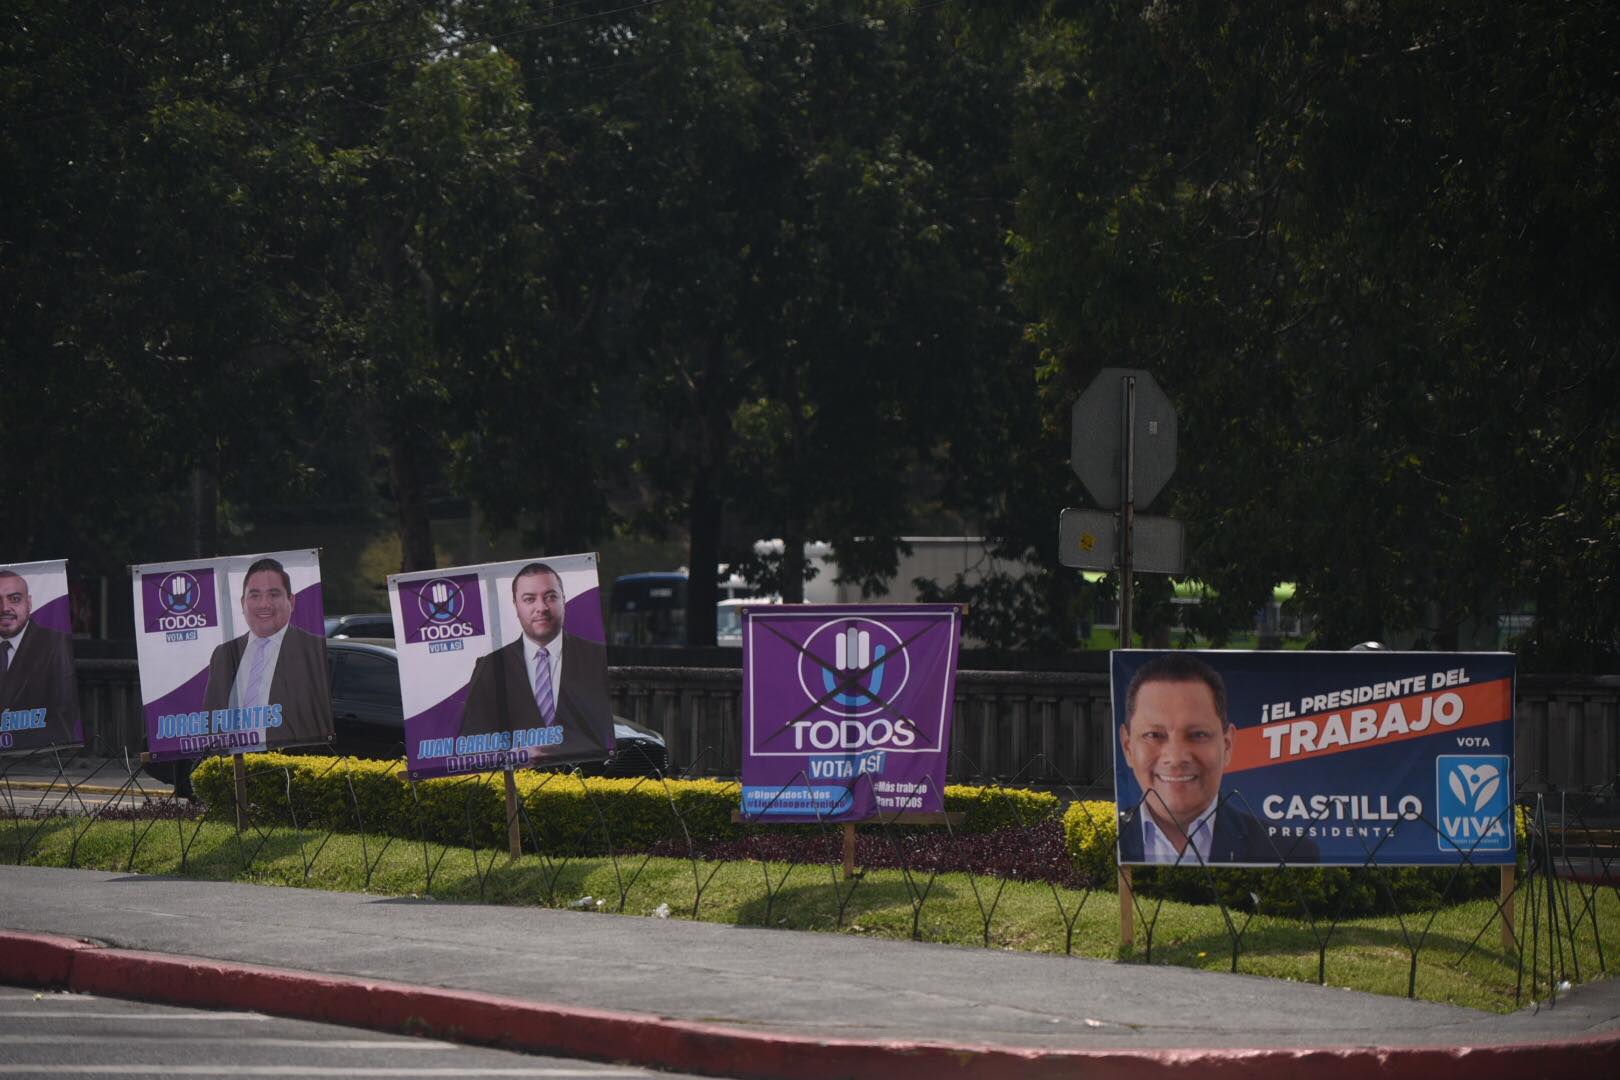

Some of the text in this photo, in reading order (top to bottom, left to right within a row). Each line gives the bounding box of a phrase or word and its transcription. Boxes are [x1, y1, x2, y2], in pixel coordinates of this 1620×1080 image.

[159, 614, 206, 630] TODOS
[418, 622, 474, 641] TODOS
[167, 633, 184, 642] VOTA
[430, 642, 448, 653] VOTA
[1261, 667, 1470, 723] ¡EL PRESIDENTE DEL
[0, 708, 47, 731] ÉNDEZ
[156, 704, 283, 739] JORGE FUENTES
[1263, 692, 1464, 759] TRABAJO
[180, 731, 260, 754] DIPUTADO
[417, 725, 564, 757] JUAN CARLOS FLORES
[786, 719, 916, 750] TODOS
[1456, 737, 1491, 747] VOTA
[446, 749, 529, 772] DIPUTADO
[811, 752, 882, 778] VOTA ASÍ
[895, 796, 923, 808] TODOS
[1262, 794, 1423, 821] CASTILLO
[1268, 826, 1396, 838] PRESIDENTE
[1442, 816, 1505, 838] VIVA
